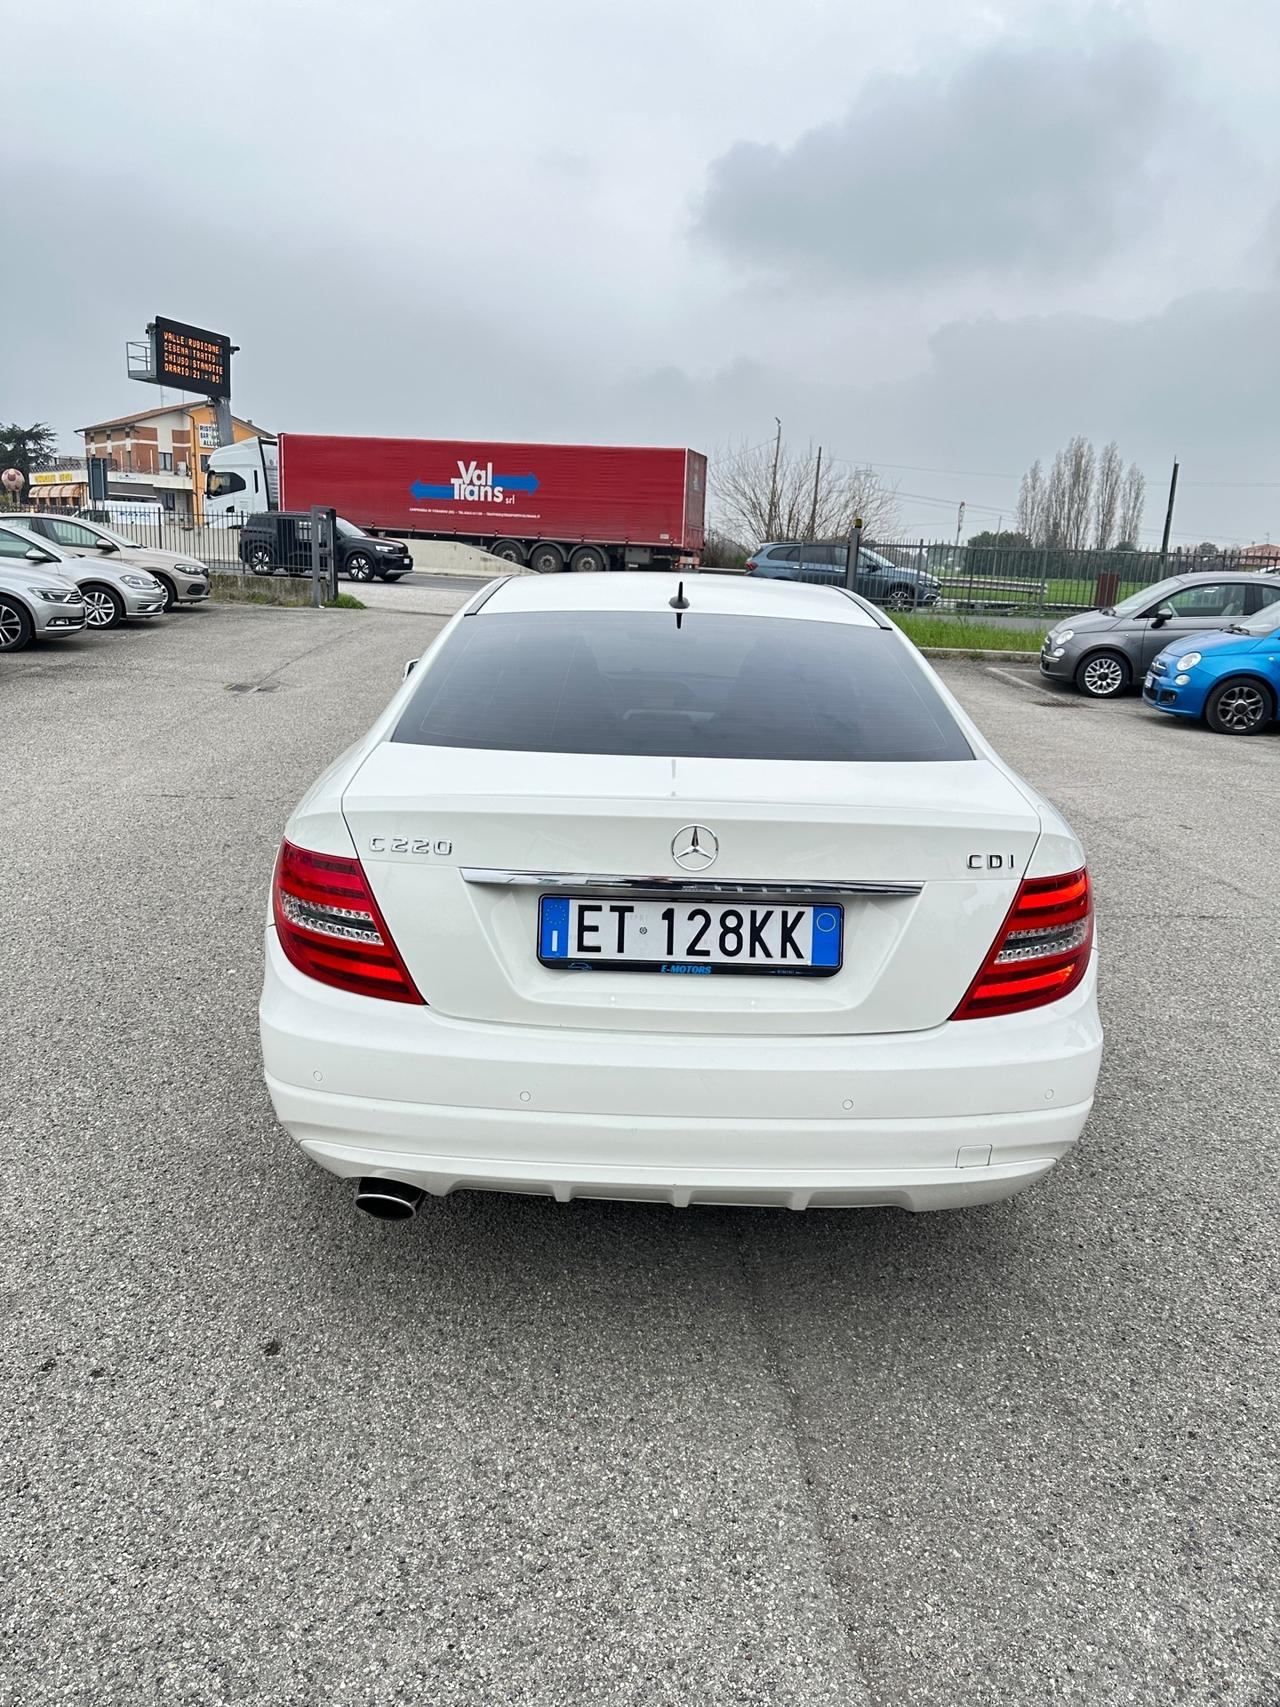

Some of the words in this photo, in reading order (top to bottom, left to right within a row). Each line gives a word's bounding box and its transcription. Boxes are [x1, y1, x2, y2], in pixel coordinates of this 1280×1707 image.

[163, 331, 185, 345] VALLE
[188, 338, 220, 354] RUBICONE
[164, 342, 189, 356] CESENA
[192, 350, 216, 363] TRATTO
[164, 353, 189, 366] CHIUSO
[192, 360, 223, 375] STANOTTE
[164, 363, 189, 376] ORARIO
[192, 371, 200, 379] 21
[211, 374, 220, 383] 05
[456, 460, 493, 486] Val
[451, 478, 504, 503] Trans
[505, 494, 515, 505] srl
[966, 853, 1014, 869] CDI
[577, 904, 635, 954] ET
[661, 907, 806, 960] 128KK
[660, 964, 712, 975] E-MOTORS
